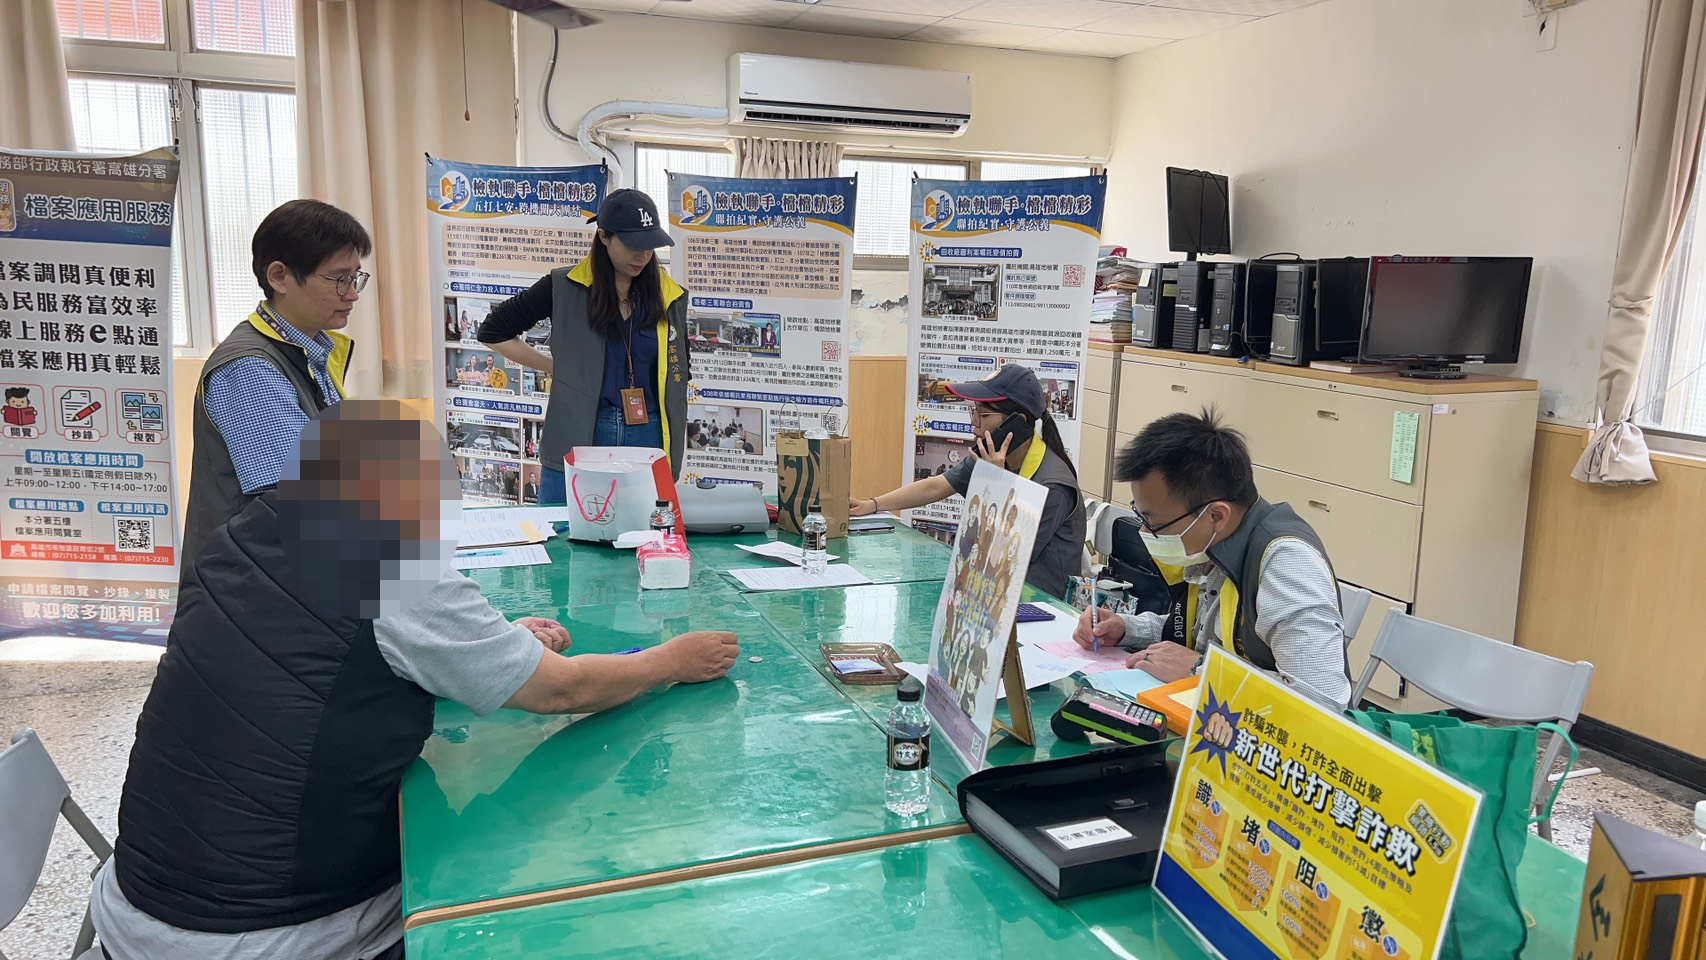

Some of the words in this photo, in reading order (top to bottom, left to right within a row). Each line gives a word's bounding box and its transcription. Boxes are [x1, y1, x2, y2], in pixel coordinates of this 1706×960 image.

[24, 193, 172, 226] 檔案應用服務
[638, 208, 653, 227] LA
[0, 261, 156, 288] 案調閱真便利
[0, 349, 161, 376] 檔案應用真輕鬆
[10, 427, 32, 437] 閱覽
[71, 430, 93, 440] 抄錄
[133, 432, 155, 443] 複製
[30, 451, 139, 467] 開放檔案應用時間
[15, 499, 79, 512] 檔案應用地點
[101, 502, 166, 515] 檔案應用資訊
[24, 515, 72, 526] 本分署五樓
[15, 527, 82, 538] 檔案應用閱覽室
[1195, 779, 1213, 808] 識
[1234, 727, 1421, 877] 新世代打擊詐欺
[1241, 814, 1261, 847] 堵
[1295, 856, 1317, 891] 阻
[1359, 905, 1385, 944] 懲
